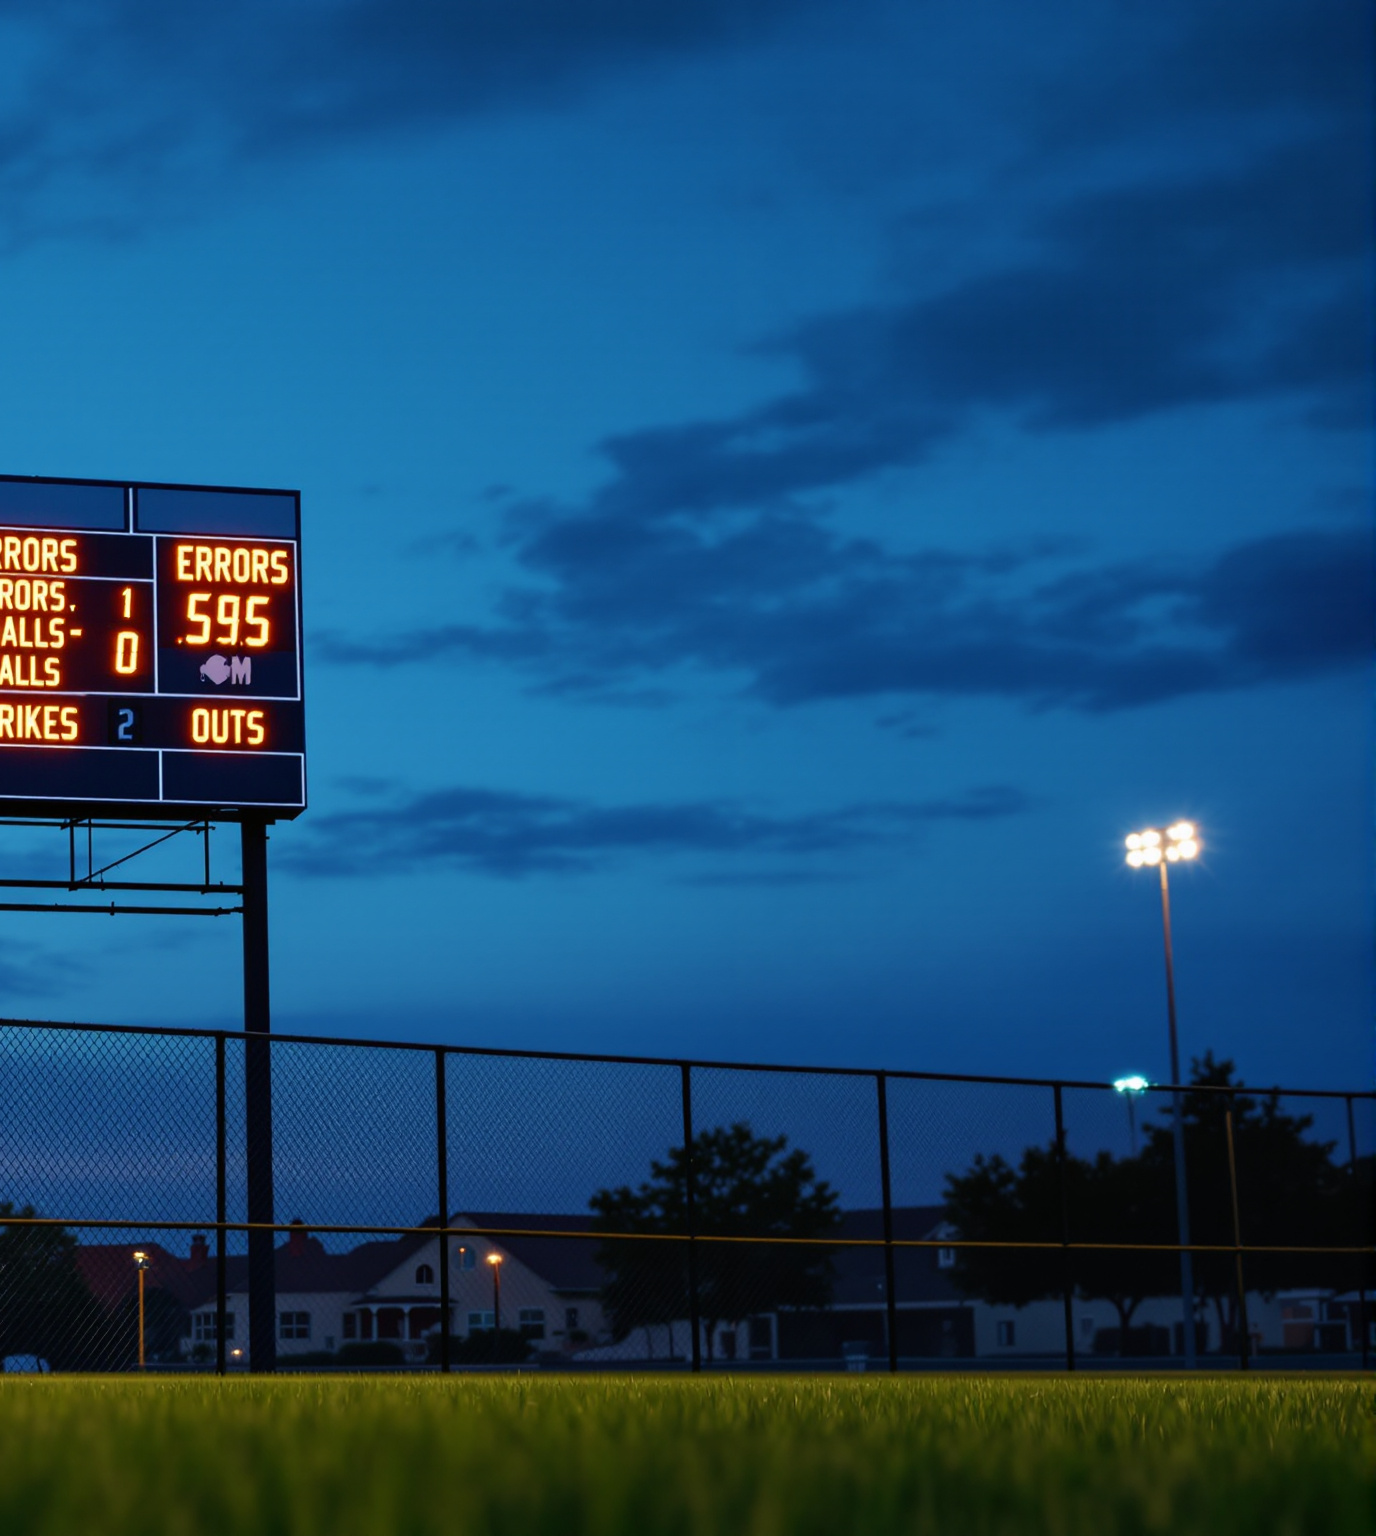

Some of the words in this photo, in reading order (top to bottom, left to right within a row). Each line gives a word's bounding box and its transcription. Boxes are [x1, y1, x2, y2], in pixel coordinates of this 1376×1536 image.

[177, 545, 288, 584] ERRORS
[122, 588, 132, 618] 1
[115, 631, 139, 674] 0
[118, 708, 134, 740] 2
[192, 708, 265, 745] OUTS
